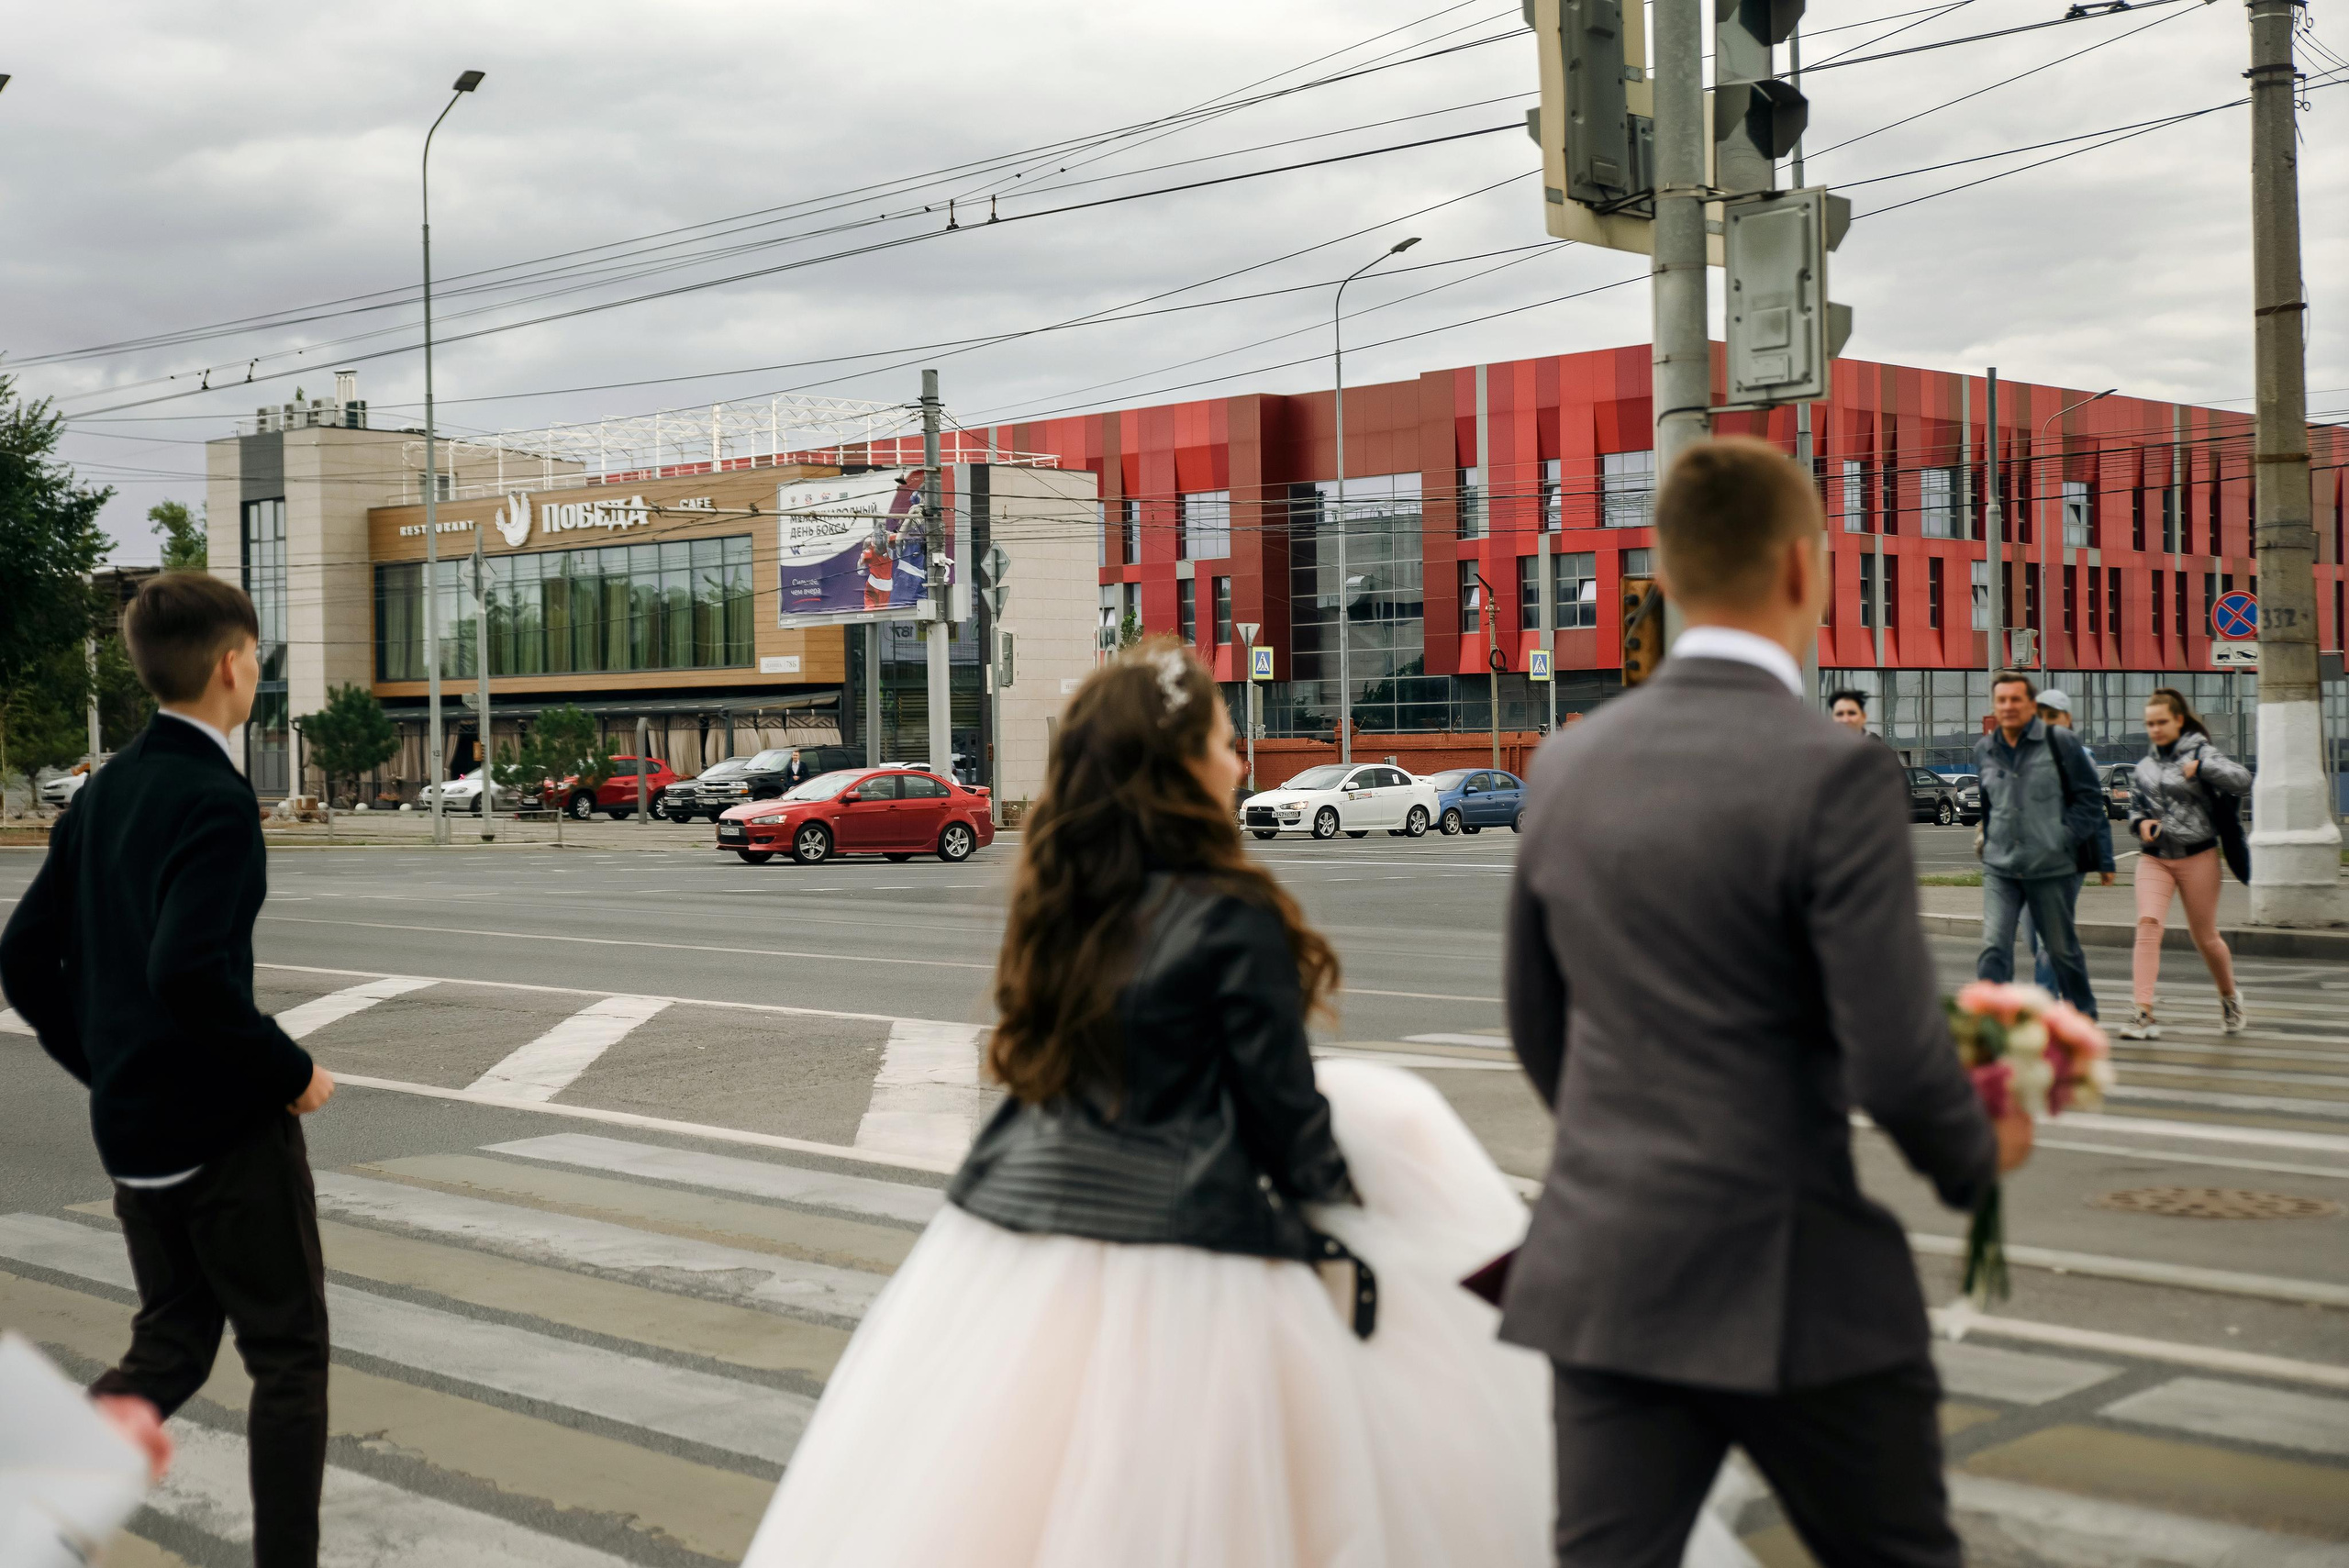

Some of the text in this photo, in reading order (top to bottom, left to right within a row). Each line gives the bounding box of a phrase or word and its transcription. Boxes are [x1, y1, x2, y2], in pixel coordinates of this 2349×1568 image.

[679, 496, 712, 508] CAFE
[541, 495, 650, 534] ПОБЕДА
[399, 519, 475, 538] RESTURANT
[790, 523, 847, 539] ДЕНЬ БОКСА
[803, 588, 822, 596] вчера
